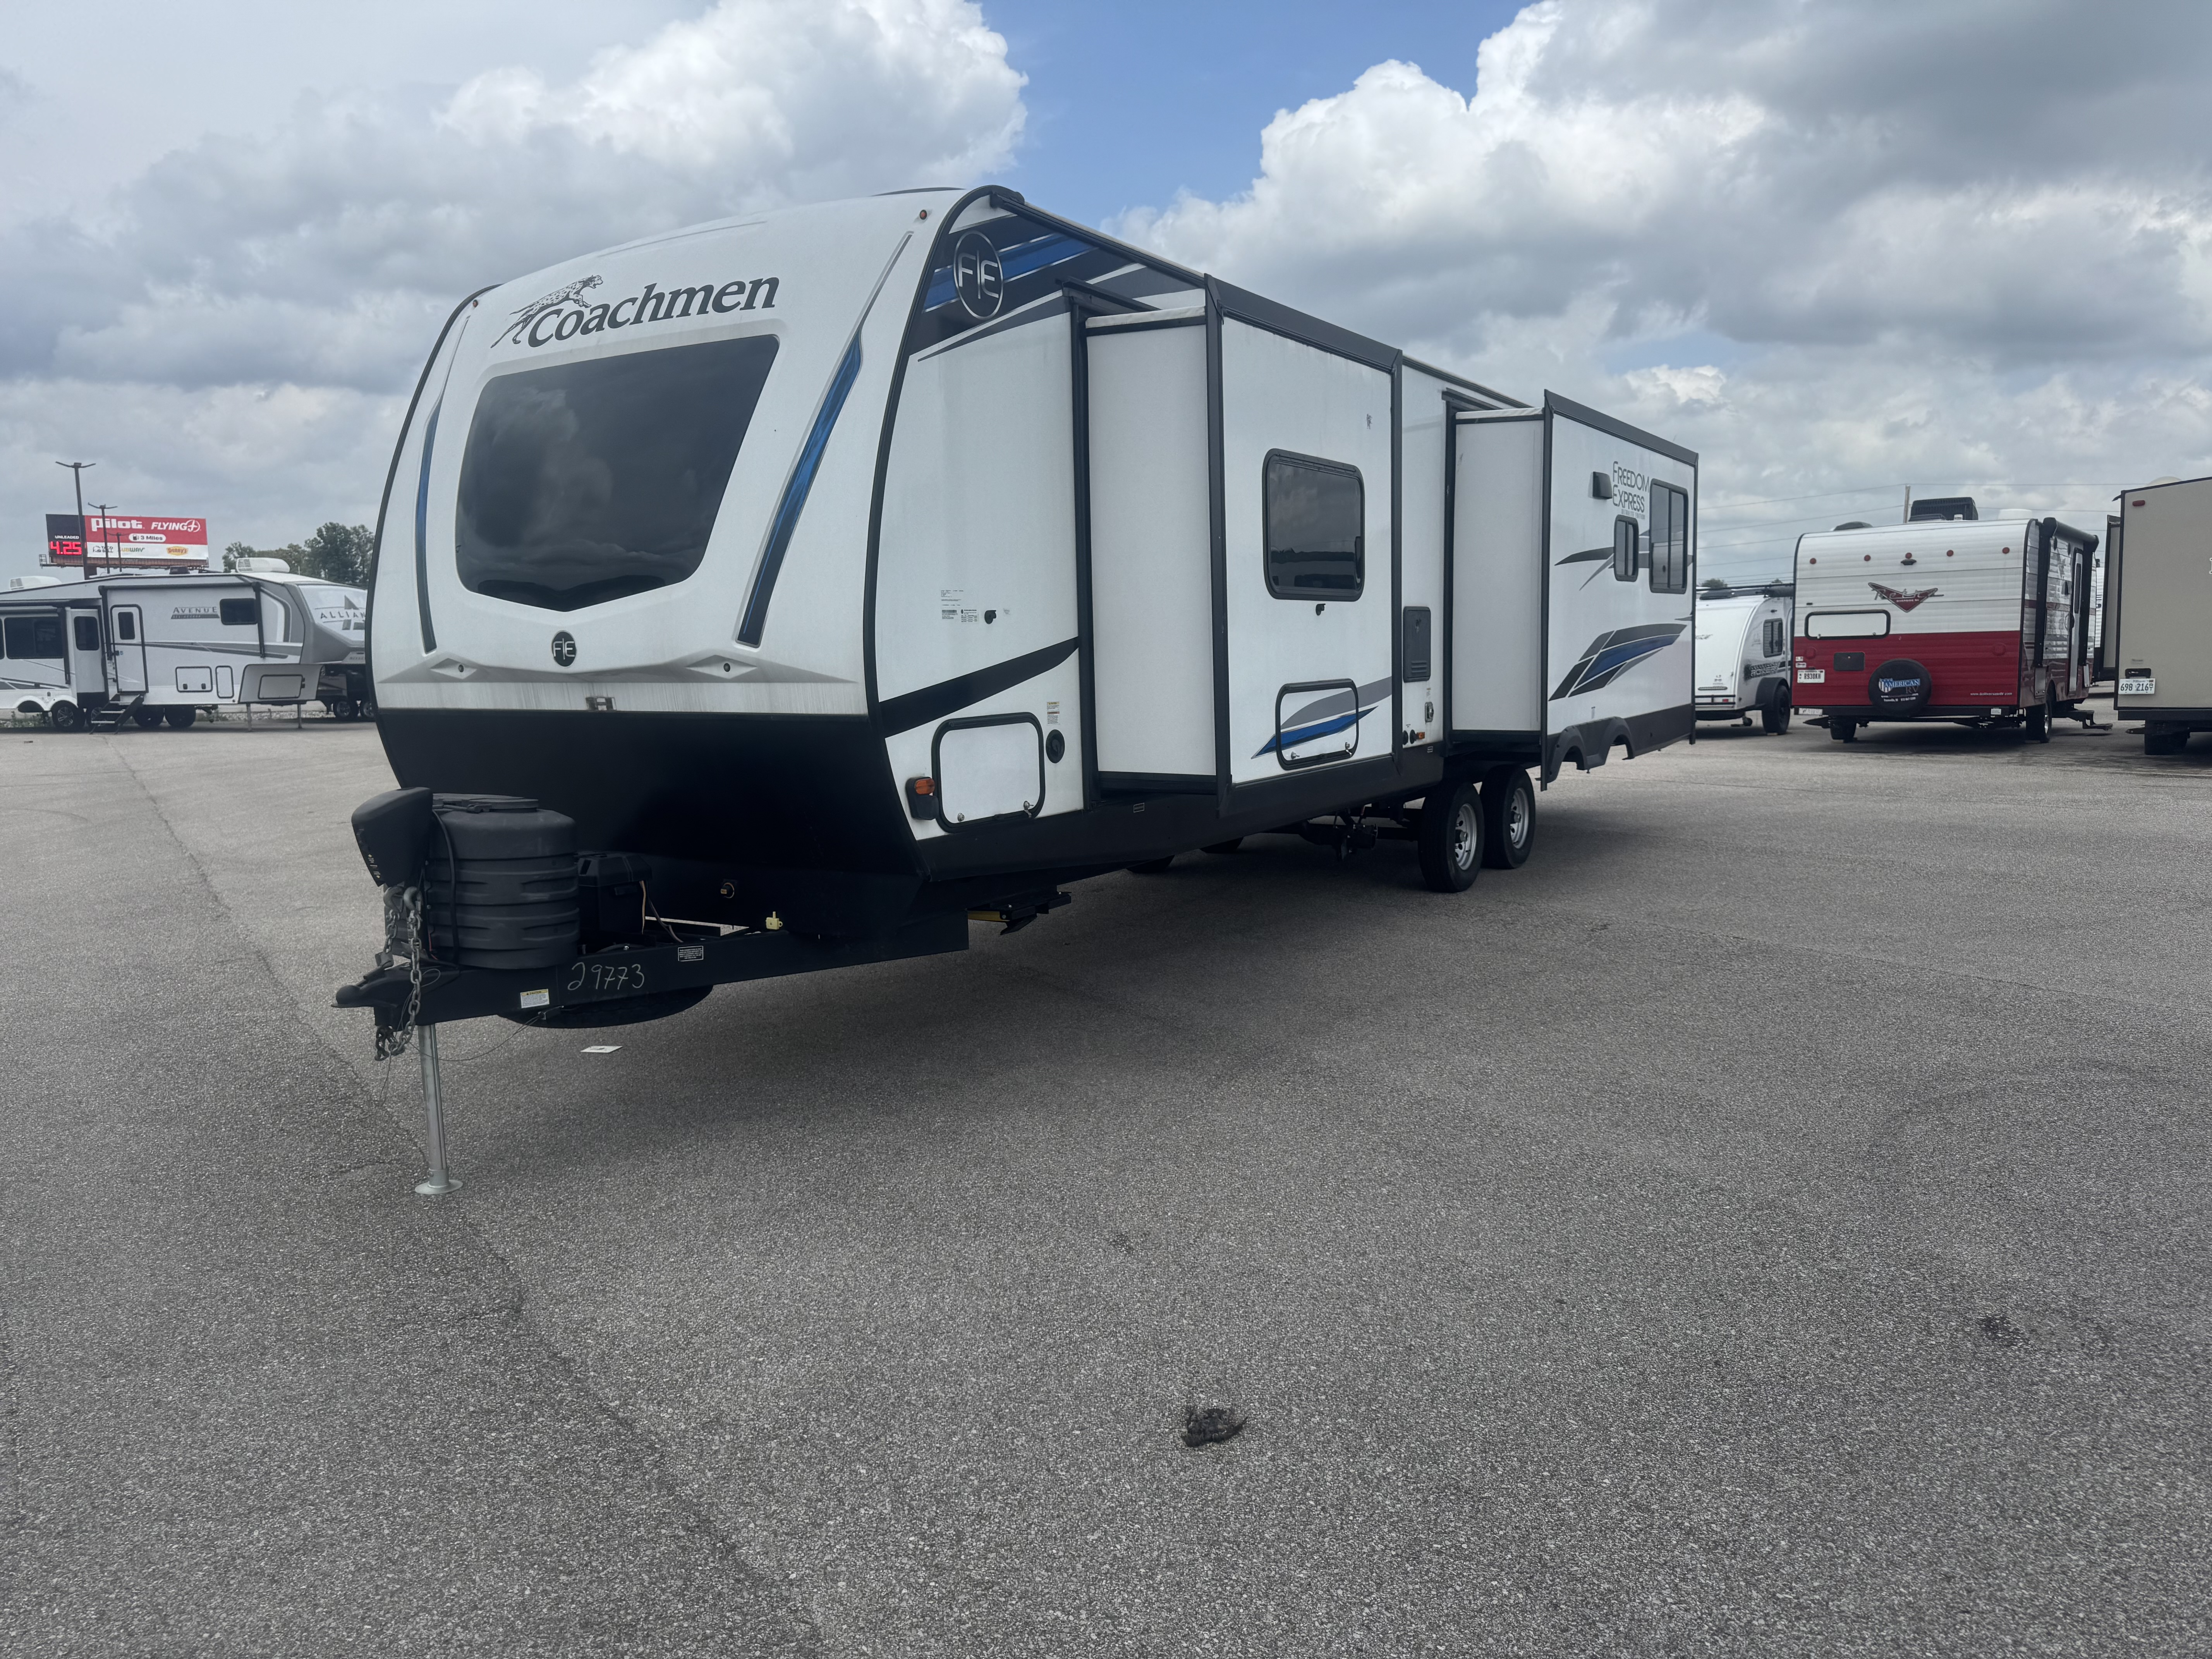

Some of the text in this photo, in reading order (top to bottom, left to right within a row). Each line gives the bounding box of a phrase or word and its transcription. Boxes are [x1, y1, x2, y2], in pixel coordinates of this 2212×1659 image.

[528, 277, 780, 348] Coachmen
[1613, 461, 1649, 493] FREEDOM
[1613, 485, 1645, 513] EXPRESS
[151, 522, 187, 530] FLYING
[50, 541, 82, 555] 4.25
[1884, 680, 1919, 688] AMERICAN
[568, 962, 645, 990] 29773
